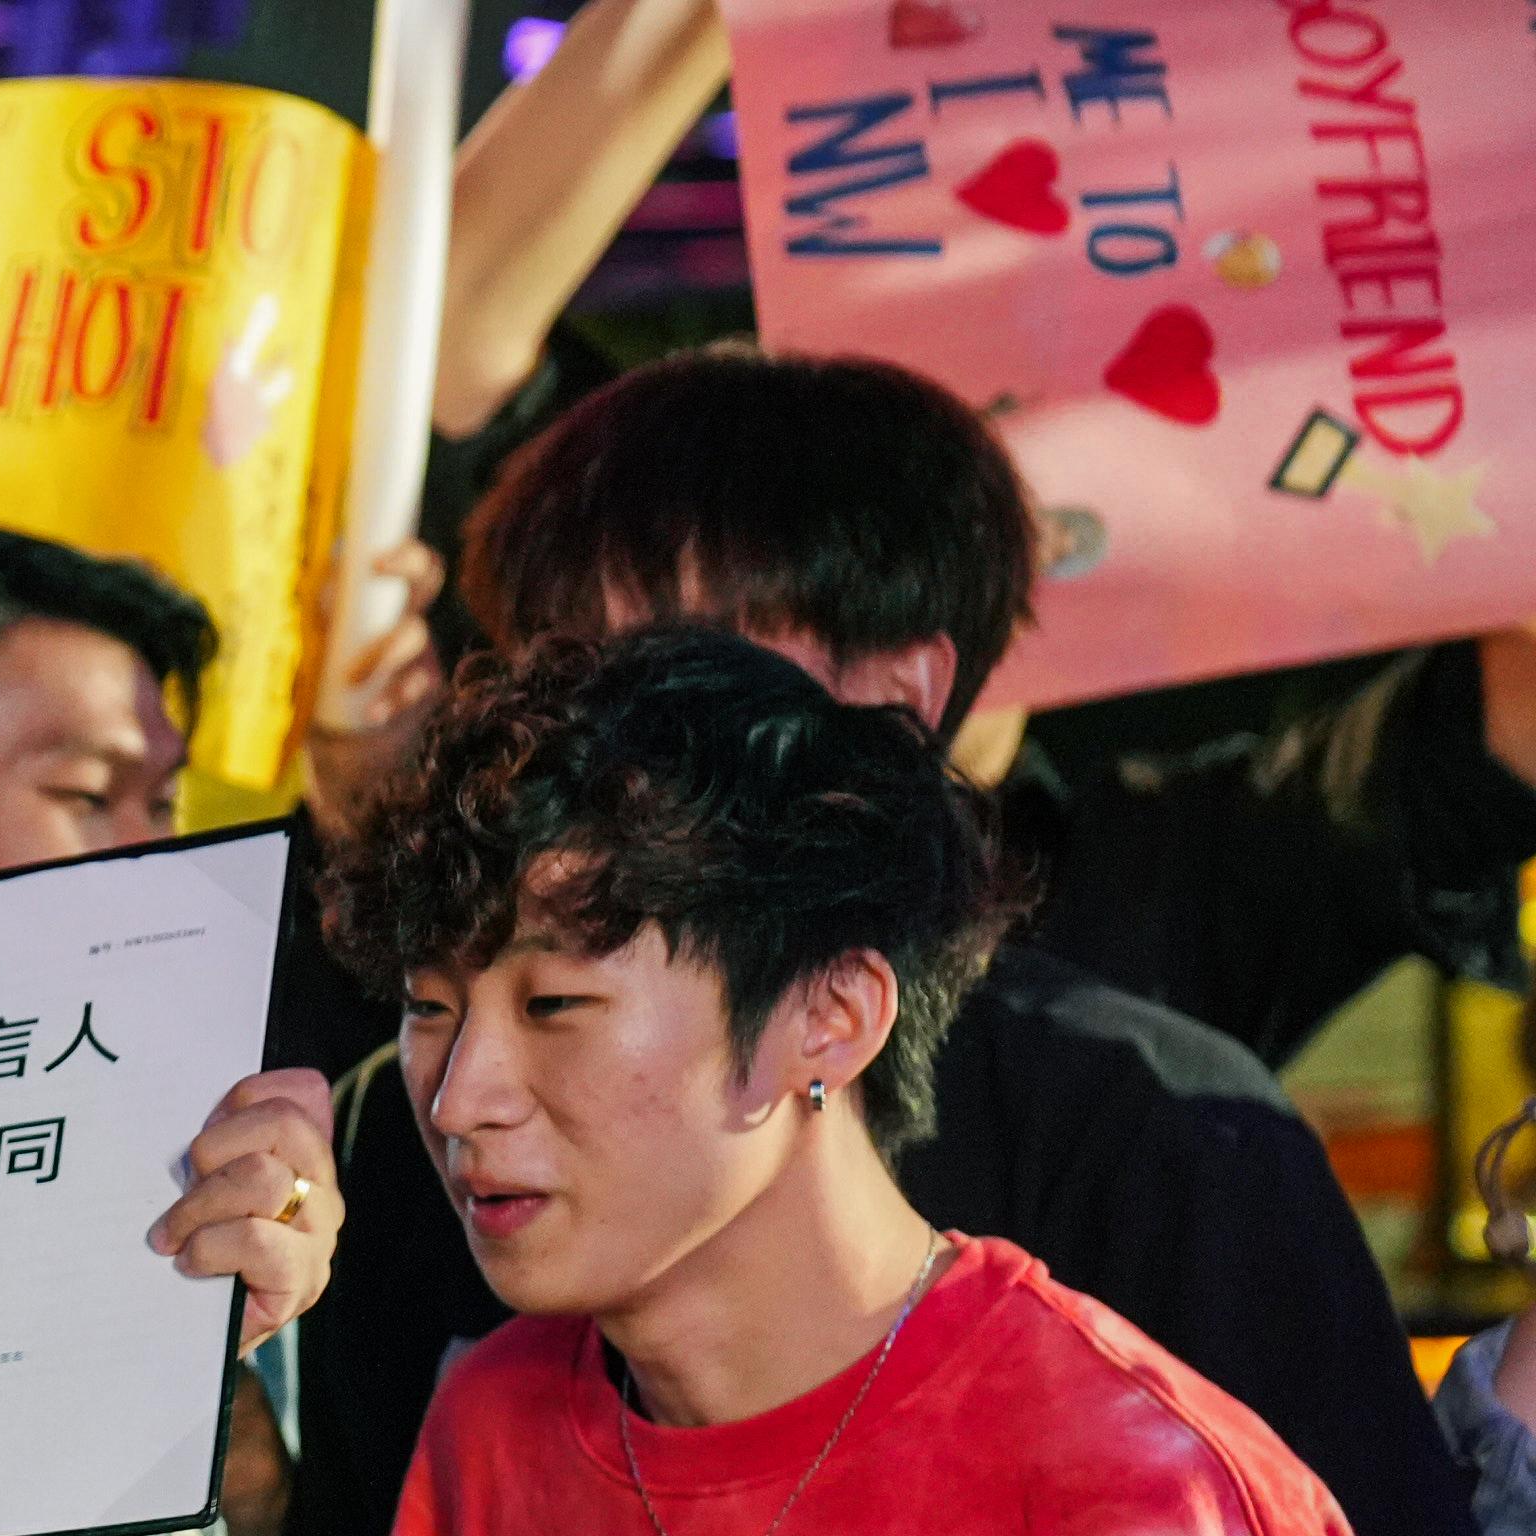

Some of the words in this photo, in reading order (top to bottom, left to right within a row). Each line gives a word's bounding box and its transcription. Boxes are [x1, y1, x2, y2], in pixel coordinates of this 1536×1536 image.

[927, 66, 1047, 119] I
[1051, 22, 1174, 128] ME
[74, 104, 304, 258] STO
[785, 92, 944, 257] NW
[1079, 160, 1186, 278] TO
[1276, 0, 1465, 457] OYFRIEND
